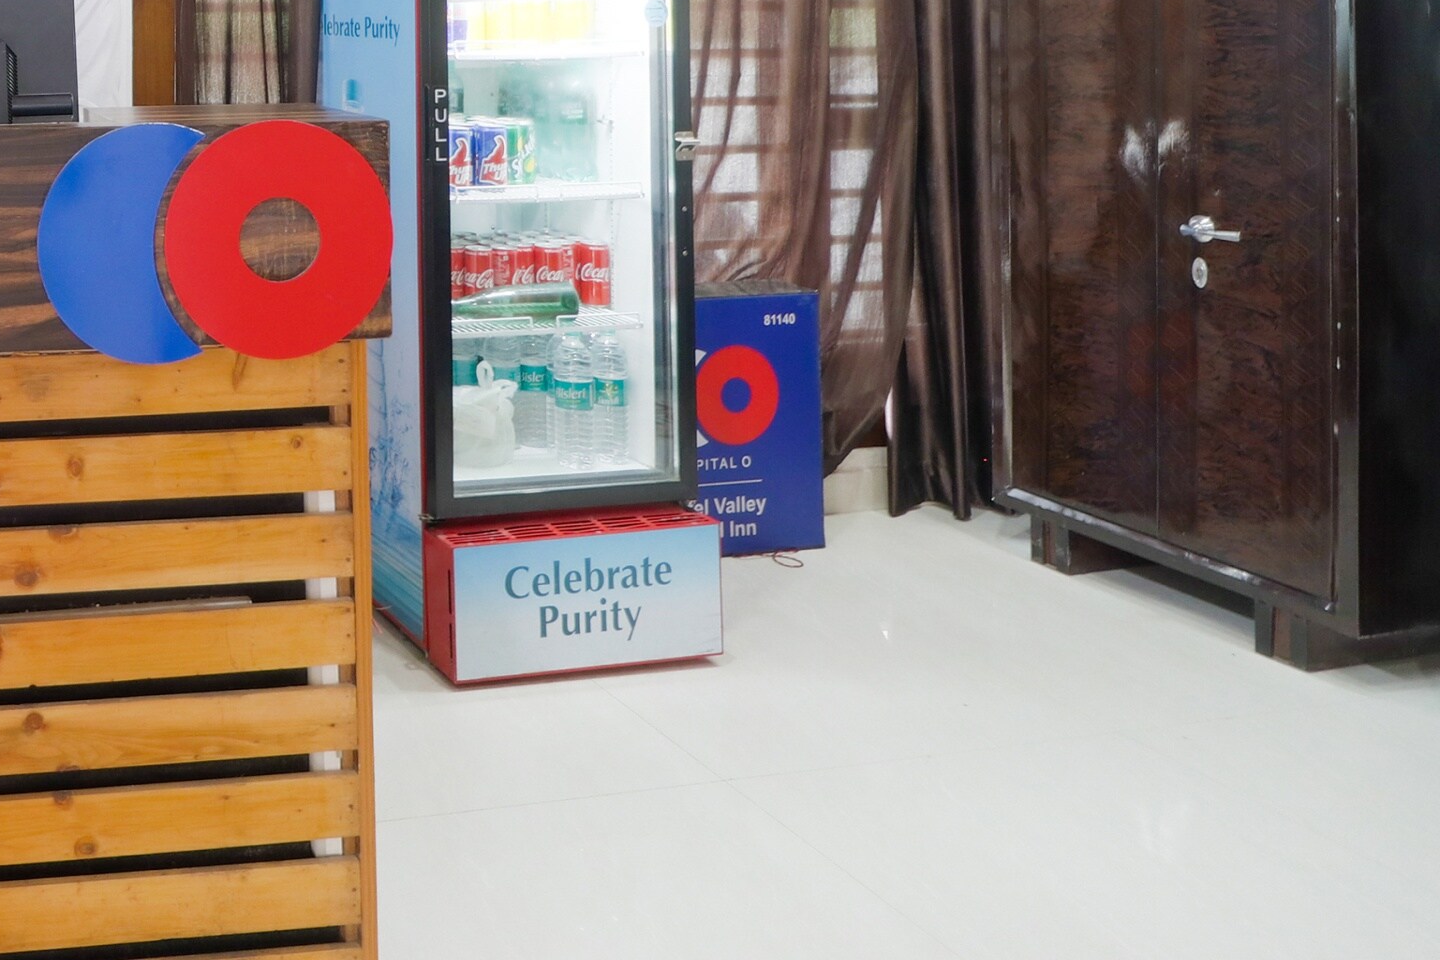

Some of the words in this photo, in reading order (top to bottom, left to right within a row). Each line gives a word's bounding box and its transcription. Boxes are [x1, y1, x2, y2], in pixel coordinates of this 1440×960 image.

[320, 13, 361, 38] lebrate
[364, 15, 400, 47] Purity
[435, 89, 448, 162] PULL
[763, 312, 796, 326] 81140
[697, 456, 737, 471] PITAL
[741, 455, 752, 468] O
[714, 495, 767, 516] Valley
[729, 520, 757, 538] Inn
[504, 556, 673, 600] Celebrate
[539, 597, 643, 641] Purity
